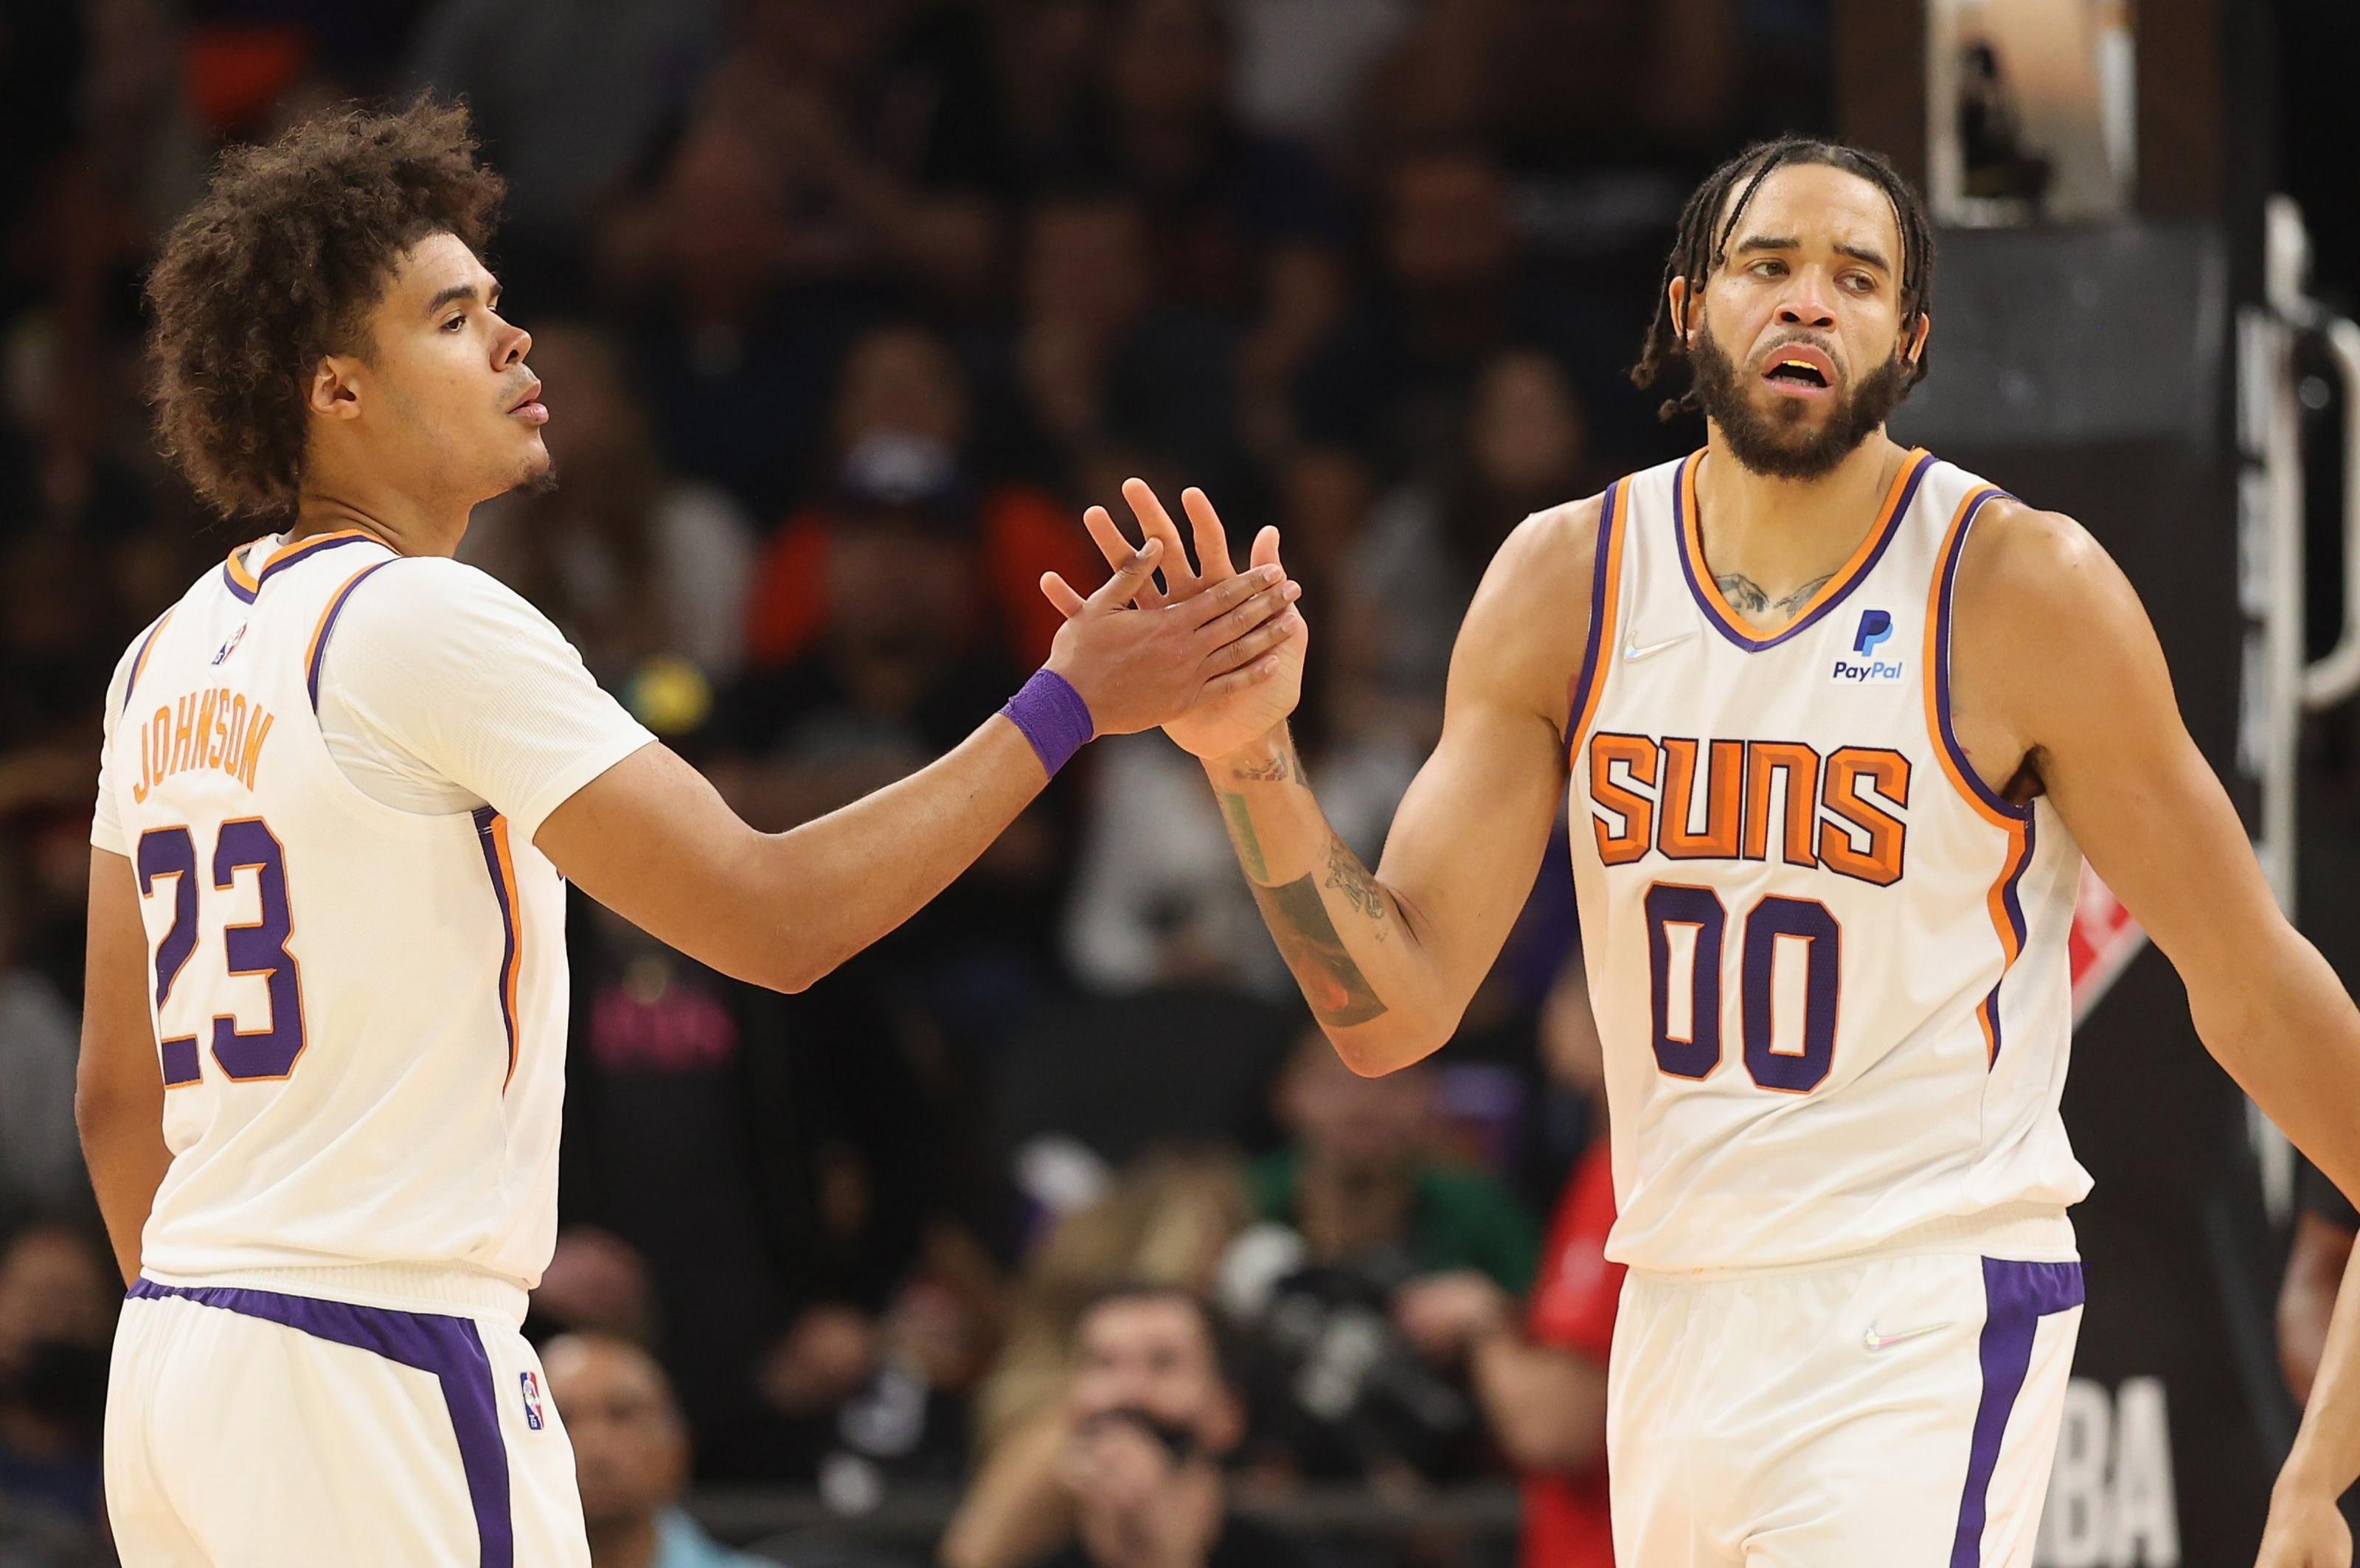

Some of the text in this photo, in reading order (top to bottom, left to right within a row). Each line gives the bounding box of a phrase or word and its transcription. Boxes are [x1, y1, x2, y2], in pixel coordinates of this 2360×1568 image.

[133, 688, 274, 804] JOHNSON
[1833, 662, 1902, 681] PayPal
[1589, 731, 1912, 887] SUNS
[137, 816, 308, 1089] 23
[1644, 881, 1842, 1095] 00
[2032, 1375, 2181, 1567] BA
